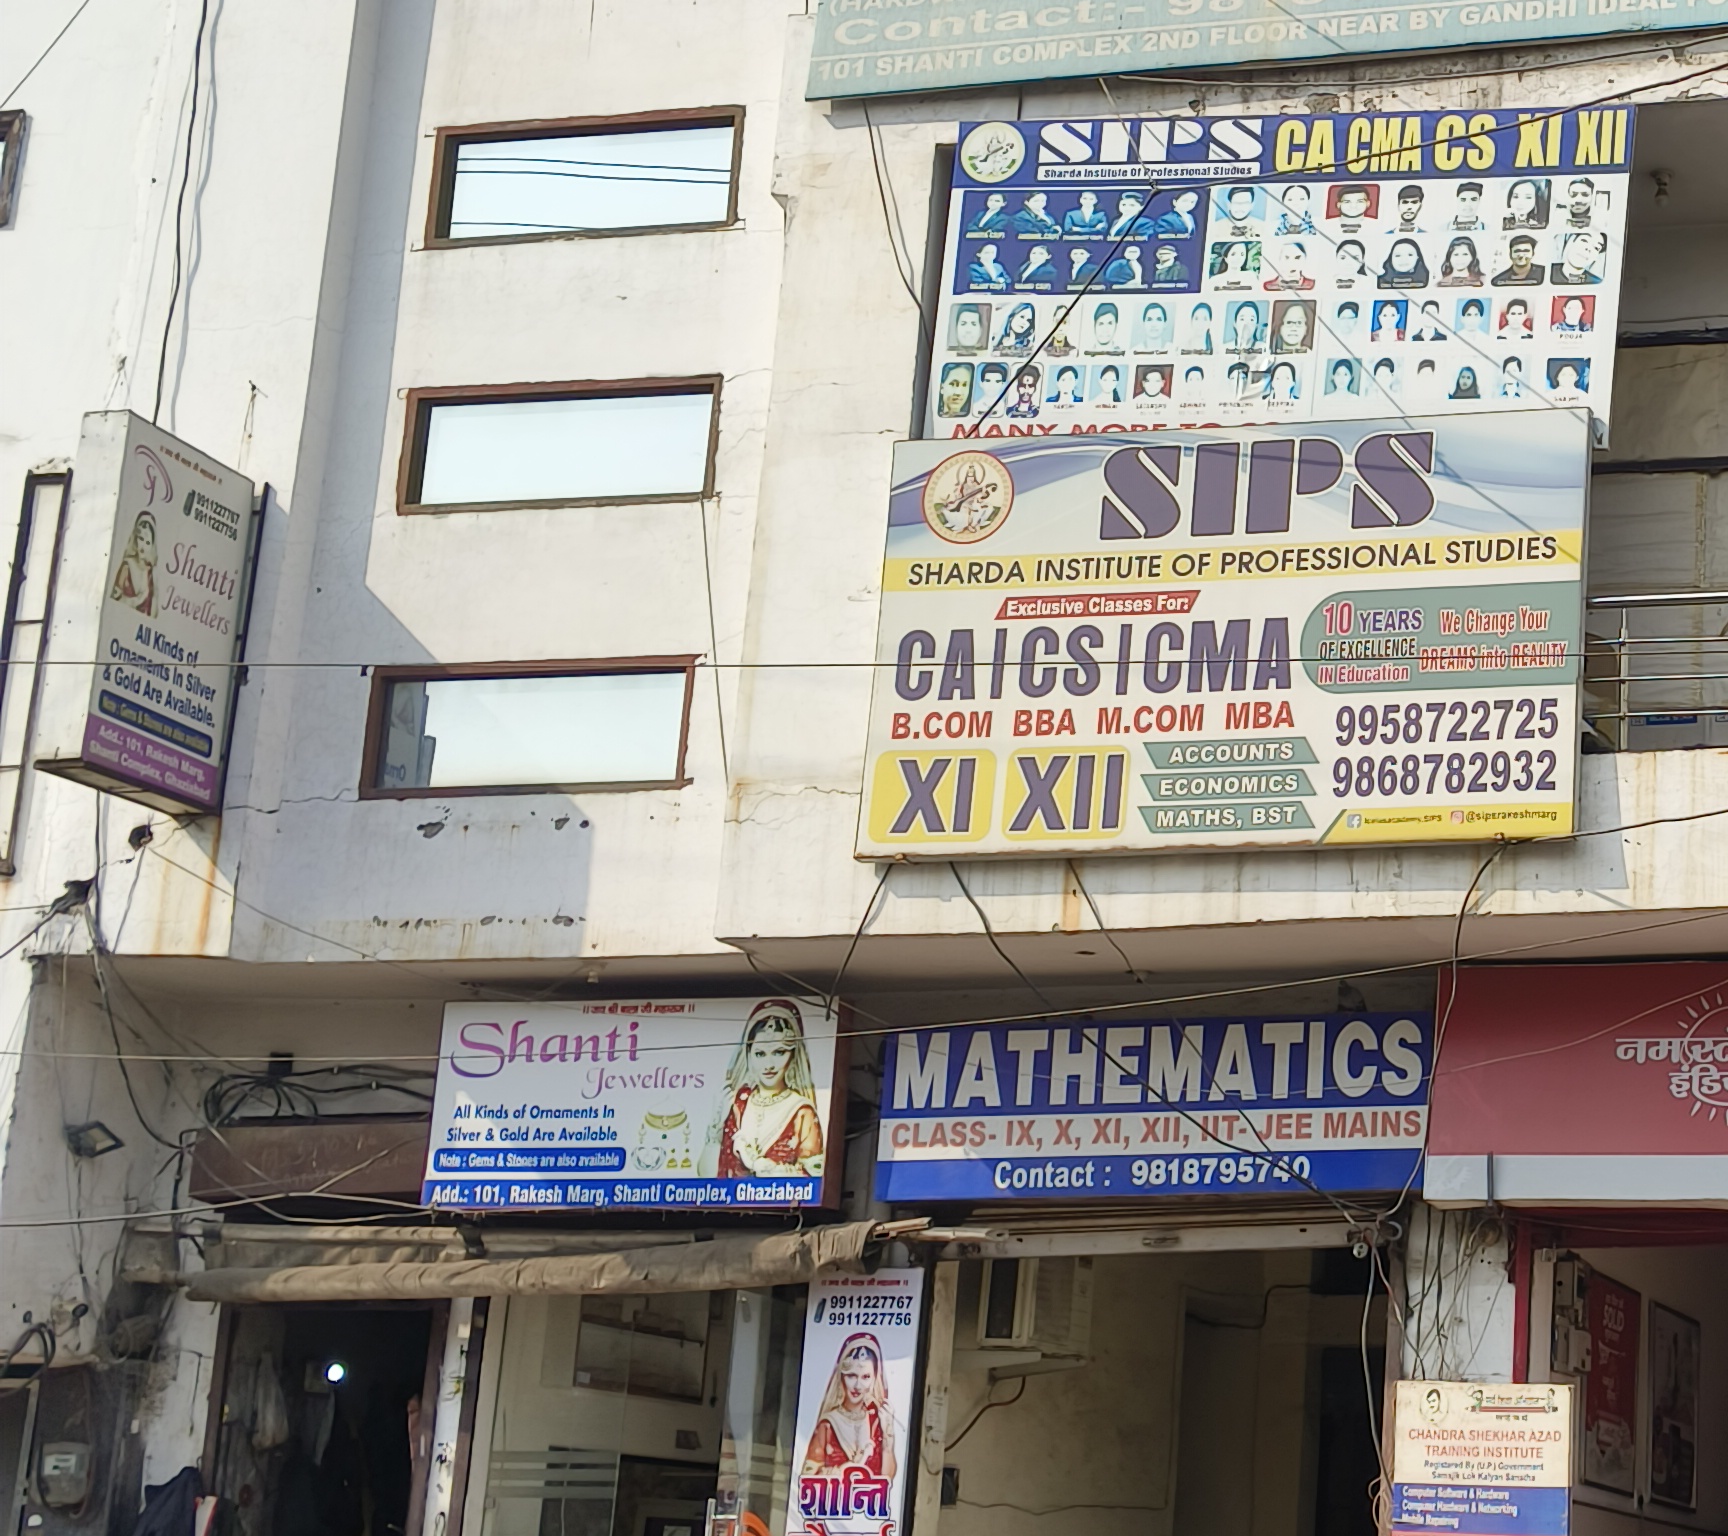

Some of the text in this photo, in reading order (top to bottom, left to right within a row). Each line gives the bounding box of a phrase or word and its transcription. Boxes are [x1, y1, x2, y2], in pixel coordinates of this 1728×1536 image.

[1038, 109, 1628, 174] SIPS CA CMA CS XI XII
[1099, 430, 1435, 541] SIPS
[165, 541, 239, 602] Shanti
[908, 536, 1558, 588] SHARDA INSTITUTE OF PROFESSIONAL STUDIES
[161, 584, 232, 637] Jewellers
[1006, 594, 1190, 618] Exclusive Classes For:
[891, 700, 1296, 741] B.COM BBA M.COM MBA
[1335, 697, 1559, 747] 9958722725
[1168, 742, 1295, 765] ACCOUNTS
[1332, 749, 1557, 798] 9868782932
[888, 753, 1126, 835] XI XII
[1158, 773, 1299, 797] ECONOMICS
[1156, 805, 1298, 830] MATHS, BST
[450, 1020, 640, 1078] Shanti
[891, 1019, 1424, 1110] MATHEMATICS
[581, 1065, 706, 1100] Jewellers
[453, 1104, 616, 1120] All Kinds of Ornaments In
[891, 1119, 997, 1150] CLASS-
[1005, 1119, 1043, 1150] IX,
[1053, 1119, 1081, 1150] X,
[1091, 1118, 1130, 1150] XI,
[1140, 1116, 1189, 1149] XII,
[1258, 1112, 1312, 1141] JEE
[1323, 1110, 1421, 1139] MAINS
[446, 1127, 618, 1142] Silver & Gold Are Available
[993, 1154, 1311, 1189] Contact 9818795740
[828, 1312, 912, 1326] 9911227756
[830, 1295, 914, 1310] 9911227767
[1408, 1428, 1562, 1443] CHANDRA SHEKHAR AZAD
[1424, 1444, 1544, 1460] TRAINING INSTITUTE
[800, 1466, 891, 1517] शान्ति
